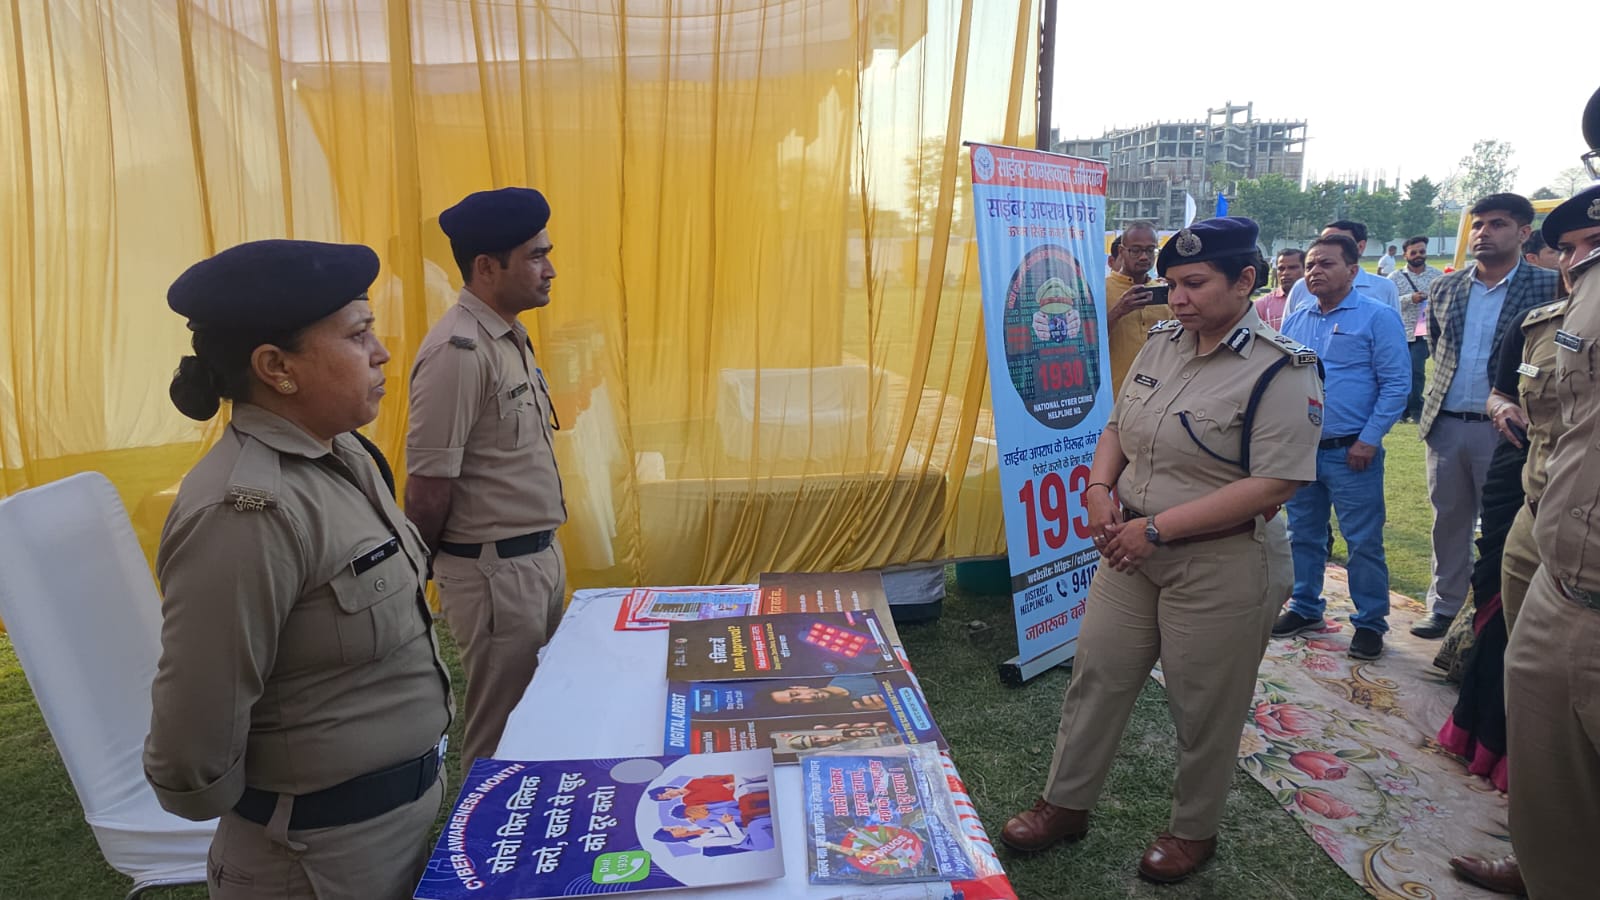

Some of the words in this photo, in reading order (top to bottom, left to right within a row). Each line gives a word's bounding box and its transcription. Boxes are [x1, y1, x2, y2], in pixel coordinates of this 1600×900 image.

[1029, 200, 1065, 221] अपराध
[1039, 359, 1084, 391] 1930
[1033, 399, 1061, 413] NATIONAL
[1060, 396, 1078, 408] CYBER
[1078, 394, 1094, 405] CRIME
[1047, 408, 1073, 420] HELPLINE
[1029, 444, 1053, 461] अपराध
[1054, 438, 1062, 452] के
[1019, 464, 1092, 558] 193
[1027, 568, 1054, 584] website:
[1024, 584, 1048, 602] DISTRICT
[1020, 597, 1045, 616] HELPLINE
[1025, 611, 1068, 641] जागरूक
[728, 625, 748, 656] Approval?
[731, 656, 746, 672] Loan
[672, 693, 686, 719] ARREST
[670, 719, 686, 748] DIGITAL
[476, 763, 525, 793] MONTH
[556, 772, 587, 793] खुद
[828, 768, 846, 794] मिलकर
[505, 775, 541, 810] क्लिक
[547, 795, 576, 806] से
[587, 785, 616, 814] करो।
[853, 792, 871, 816] अलख
[872, 796, 890, 808] को
[895, 793, 916, 805] दूर
[830, 795, 849, 816] आओ
[874, 809, 893, 822] नशे
[896, 805, 913, 814] से
[448, 792, 485, 855] AWARENESS
[496, 812, 531, 837] फिर
[543, 808, 572, 839] खतरे
[587, 815, 618, 832] दूर
[578, 833, 608, 852] को
[859, 853, 877, 867] NO
[874, 834, 908, 857] DRUGS
[486, 839, 523, 874] सोचो
[532, 841, 569, 874] करो,
[450, 855, 485, 891] CYBER
